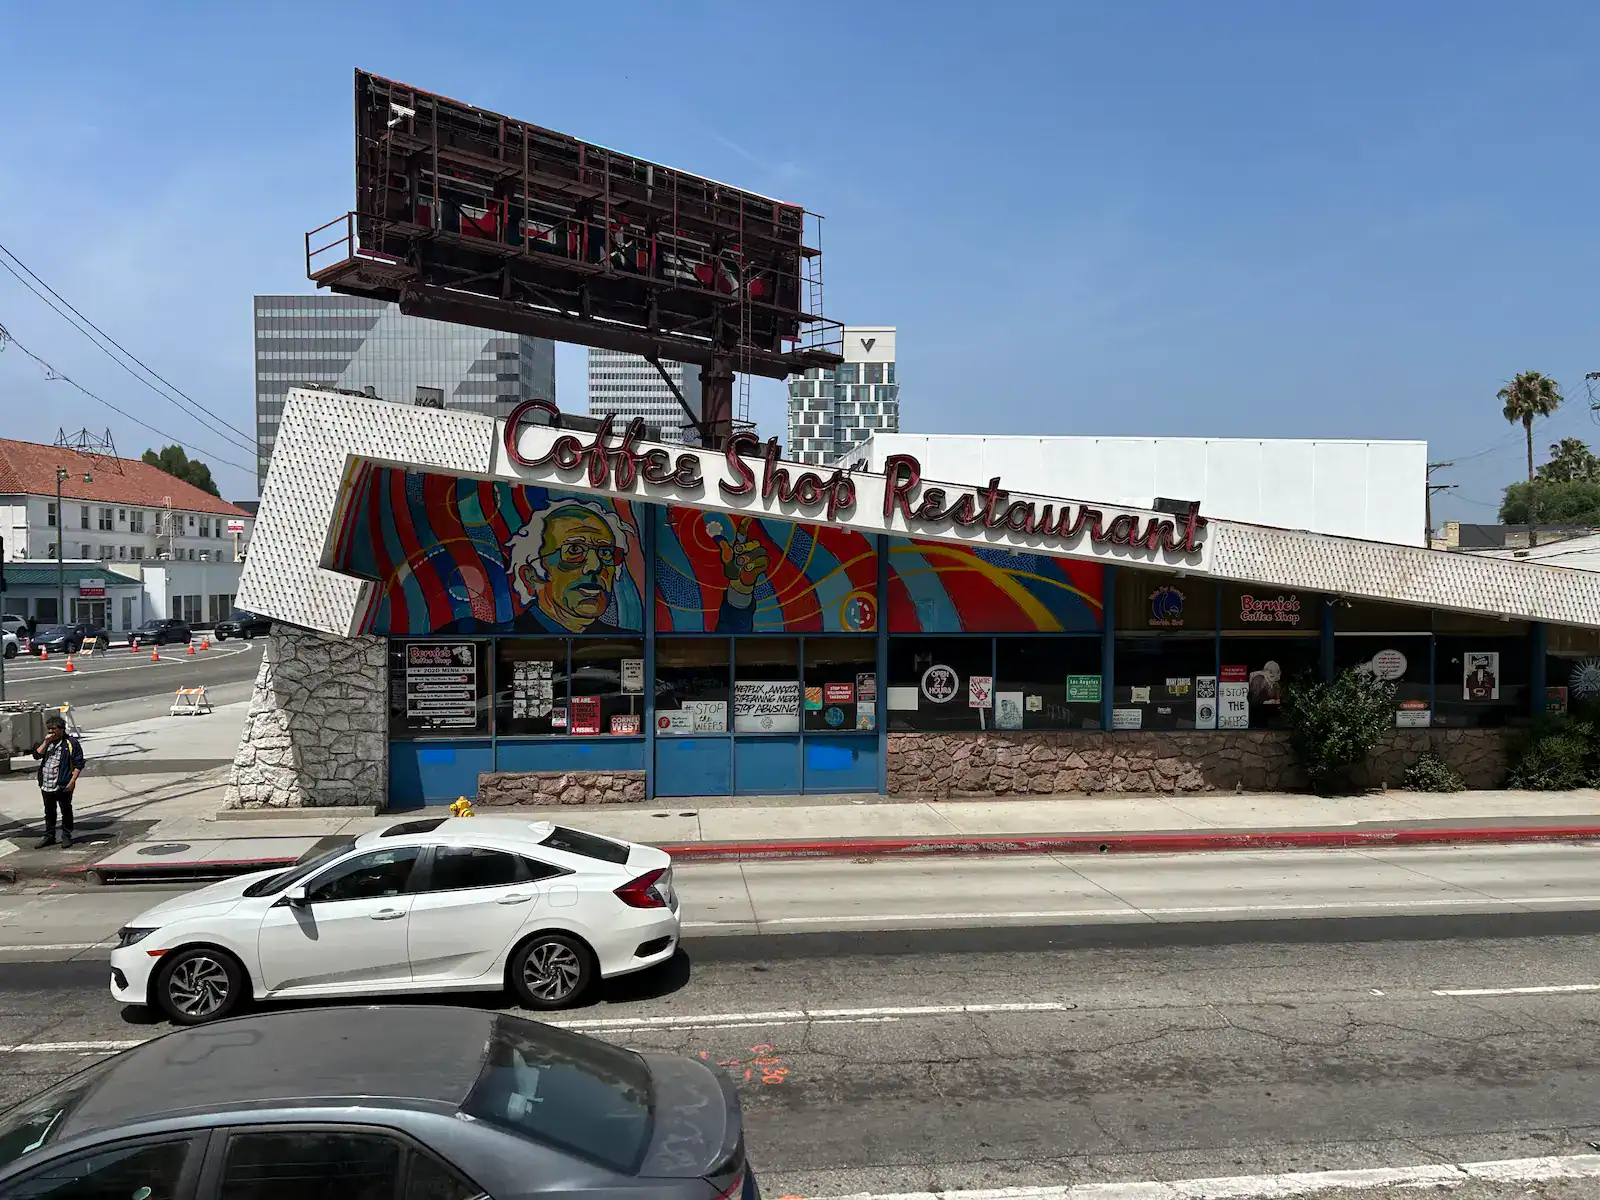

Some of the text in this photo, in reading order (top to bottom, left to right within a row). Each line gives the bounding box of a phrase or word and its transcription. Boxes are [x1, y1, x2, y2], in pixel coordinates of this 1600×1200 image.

[503, 398, 1208, 553] Coffee Shop Restaurant
[1240, 595, 1300, 612] Bernie's
[1240, 611, 1300, 625] Coffee Shop
[410, 646, 452, 658] Bernie's
[434, 658, 452, 666] Shop
[931, 670, 949, 678] OPEN
[934, 678, 947, 688] 27
[734, 694, 775, 703] STREAMING
[734, 703, 755, 713] STOP
[1228, 701, 1244, 711] THE
